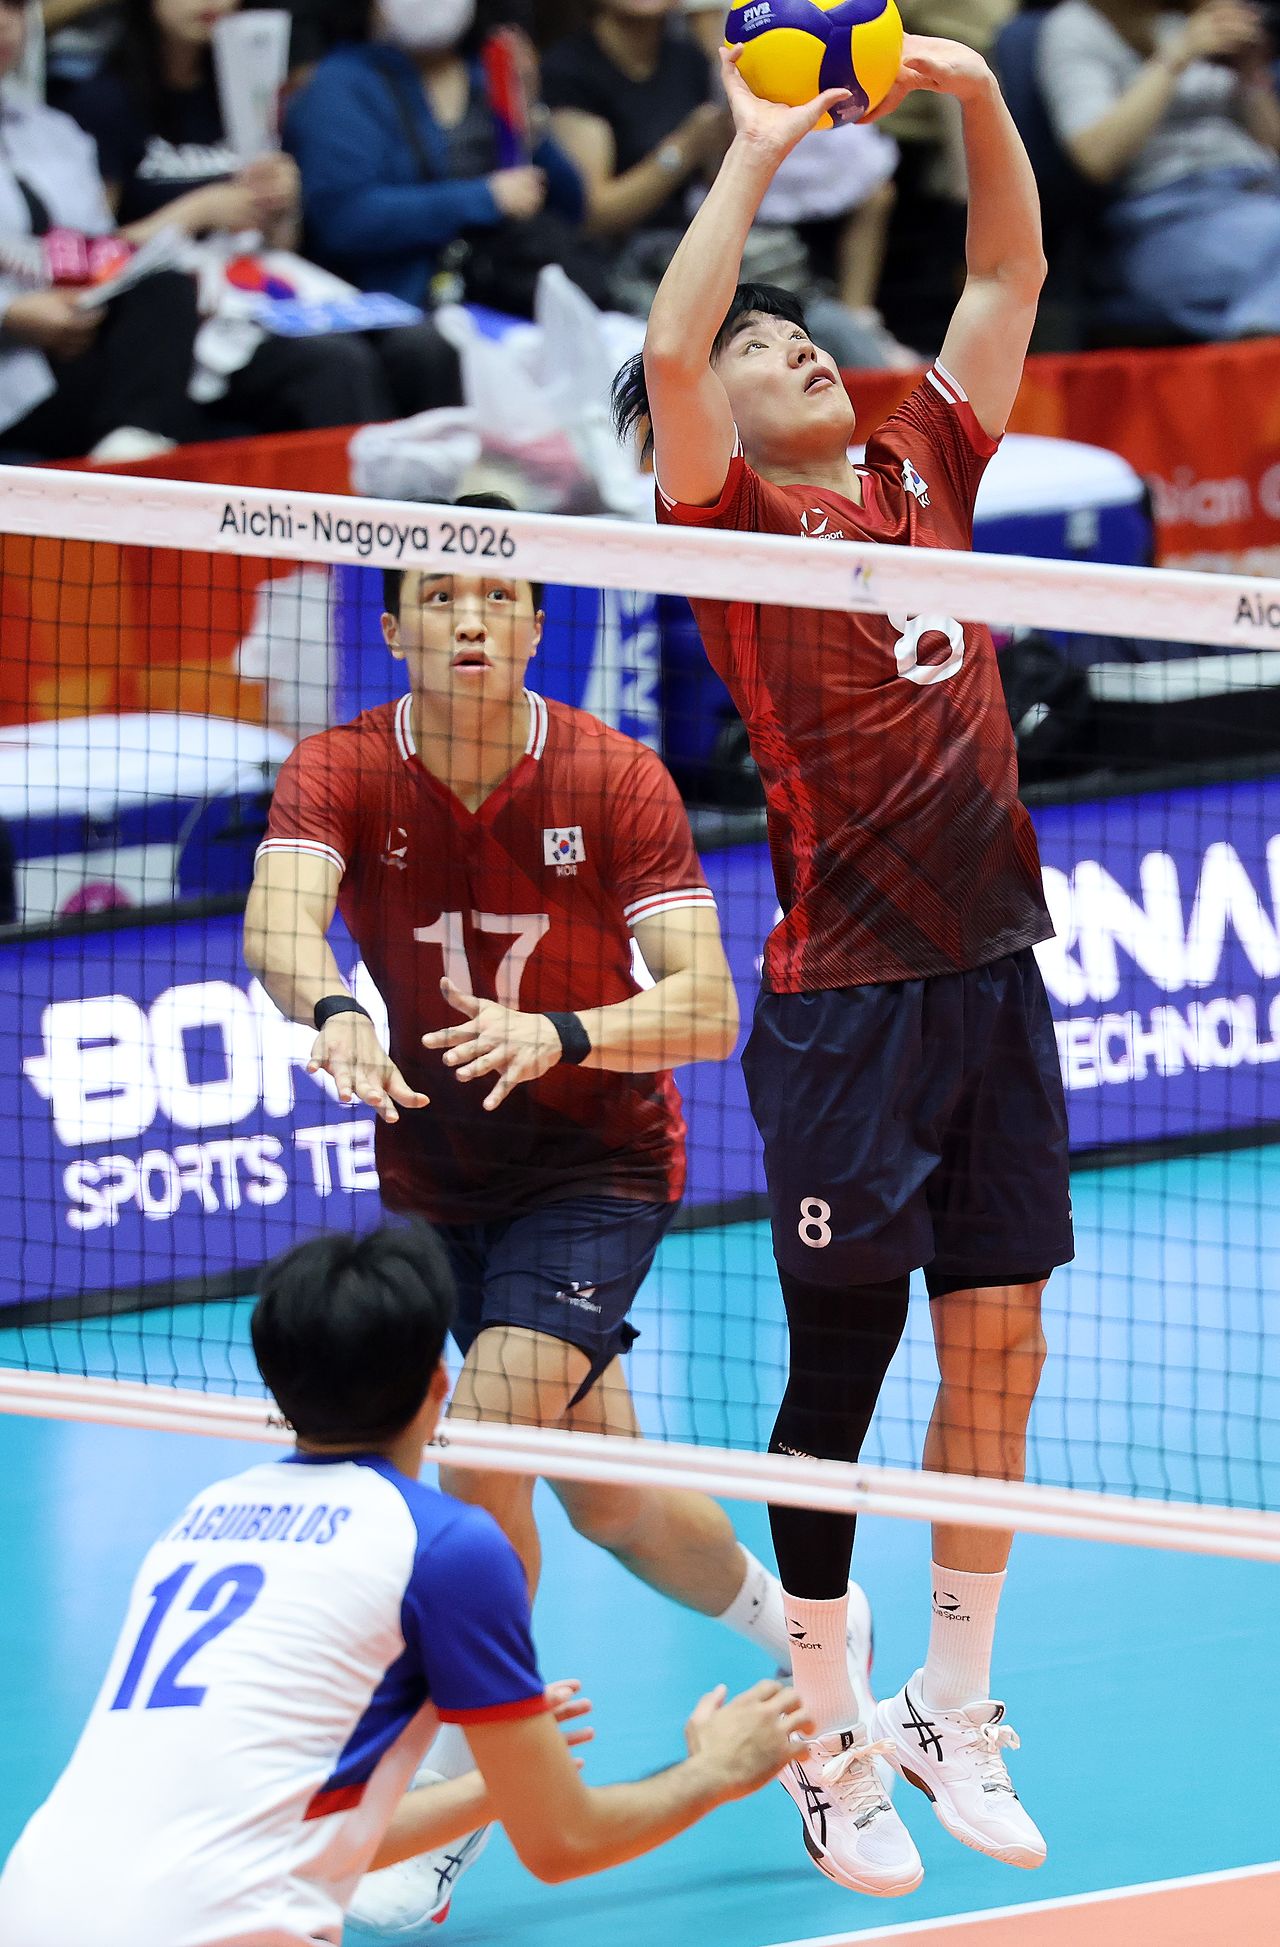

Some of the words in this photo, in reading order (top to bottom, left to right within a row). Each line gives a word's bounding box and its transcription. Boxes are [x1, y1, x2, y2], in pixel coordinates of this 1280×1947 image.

[220, 501, 429, 559] Aichi-Nagoya
[440, 521, 516, 558] 2026
[413, 909, 551, 1011] 17
[63, 1135, 288, 1230] SPORTS
[798, 1197, 832, 1248] 8
[110, 1562, 265, 1711] 12
